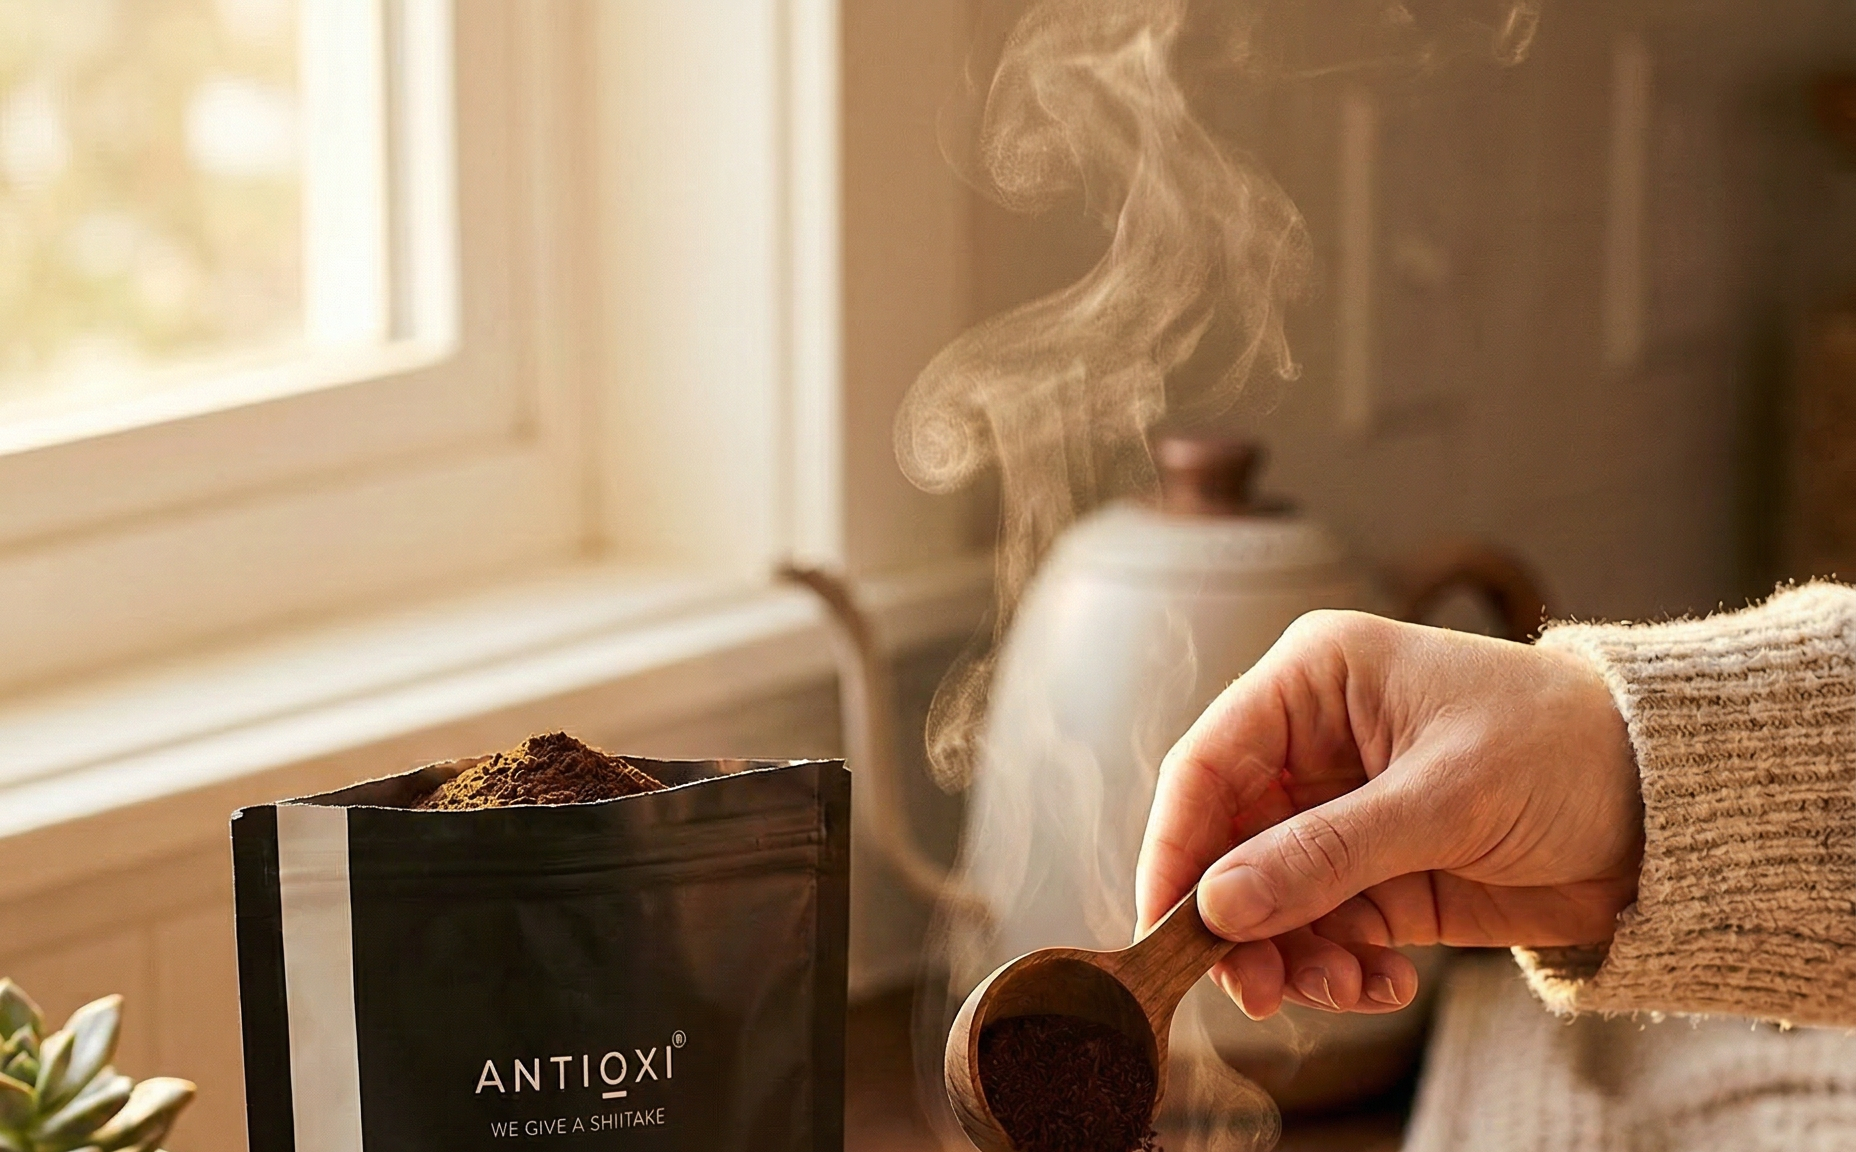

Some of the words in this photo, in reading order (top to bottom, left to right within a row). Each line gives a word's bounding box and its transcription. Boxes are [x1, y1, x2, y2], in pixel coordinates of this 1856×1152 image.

[491, 1122, 518, 1137] WE
[525, 1118, 567, 1135] GIVE
[572, 1117, 585, 1133] A
[591, 1107, 665, 1131] SHIITAKE
